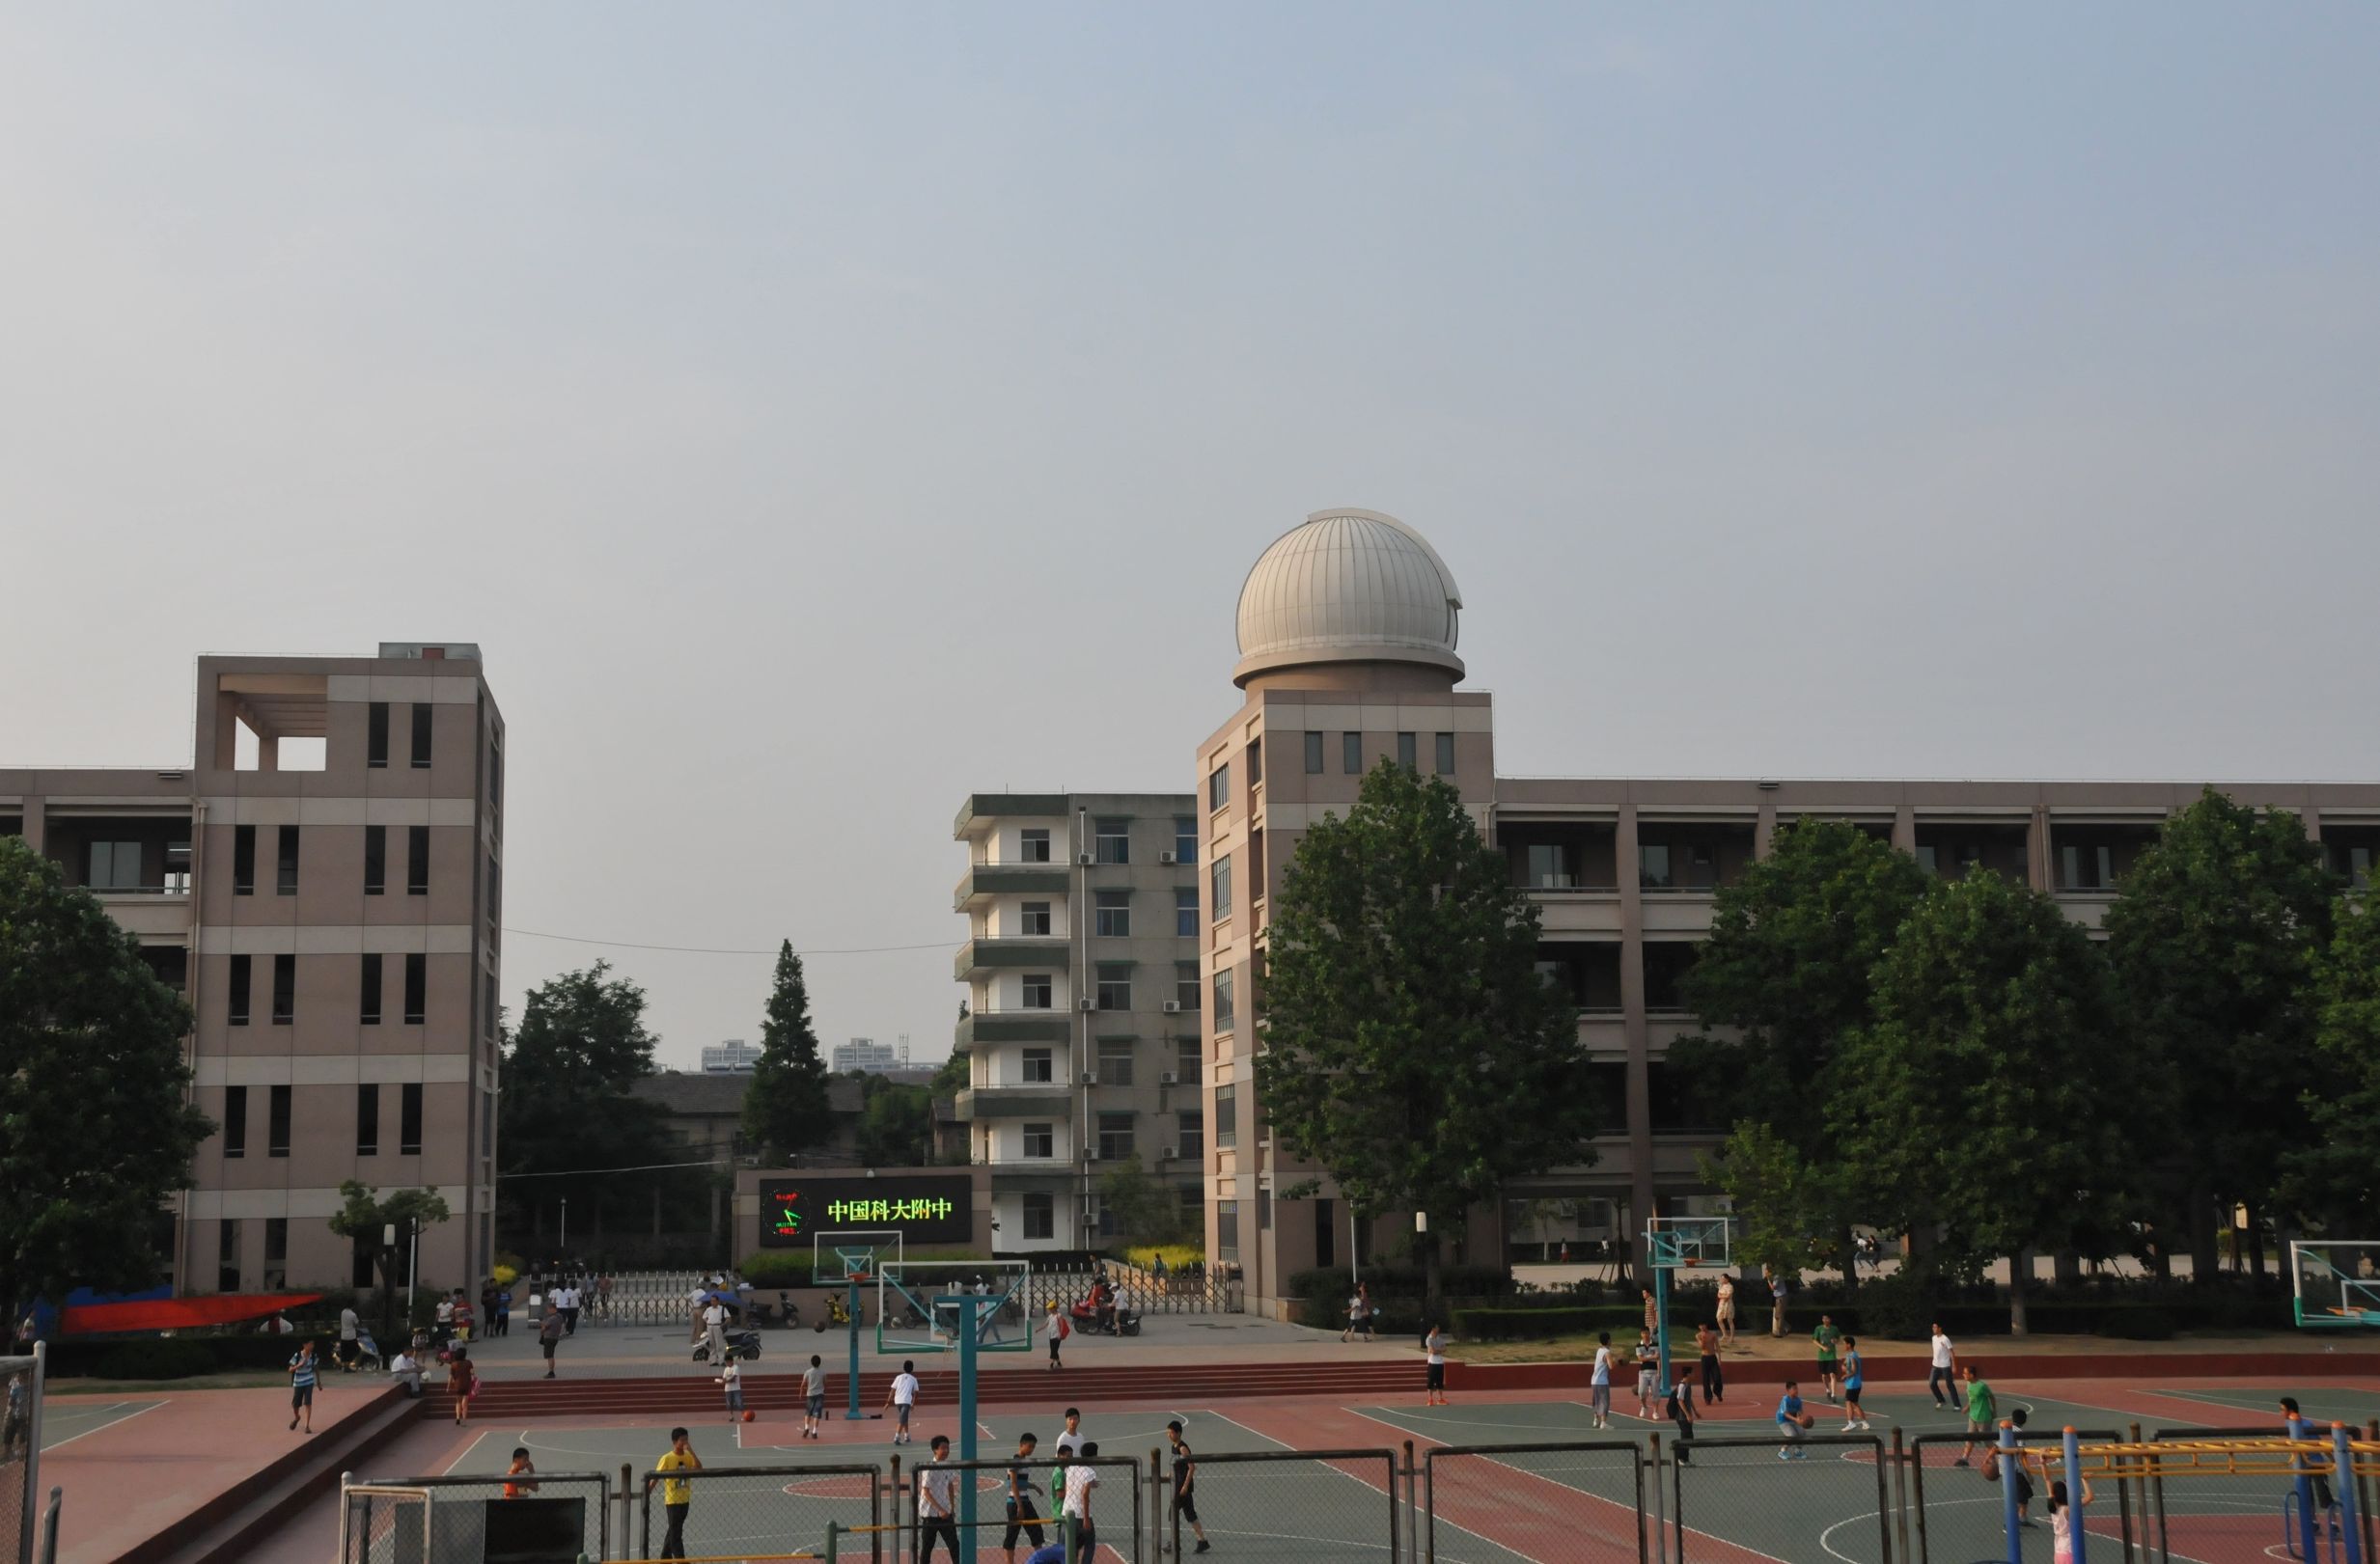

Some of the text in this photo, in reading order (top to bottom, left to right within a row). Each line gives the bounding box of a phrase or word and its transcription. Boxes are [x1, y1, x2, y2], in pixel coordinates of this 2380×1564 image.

[827, 1197, 952, 1222] 中国科大附中
